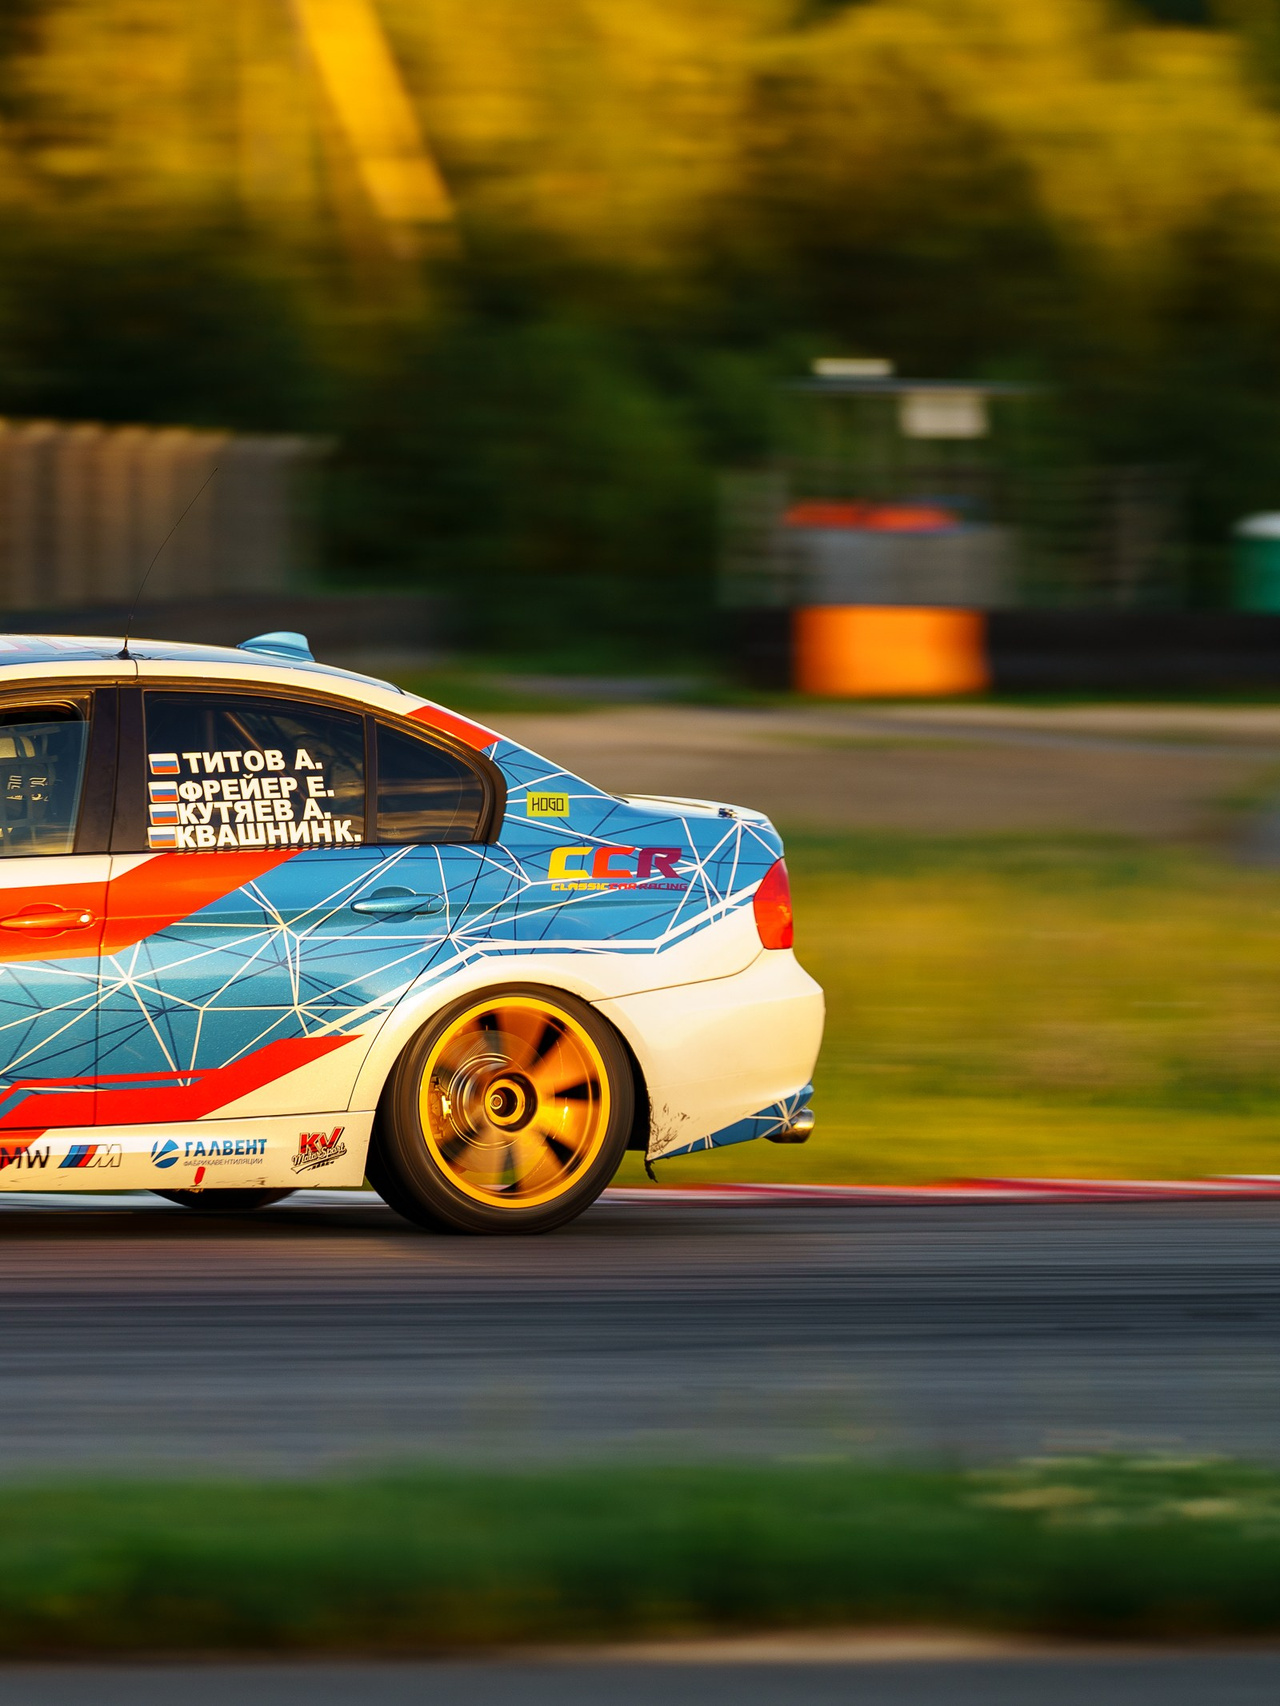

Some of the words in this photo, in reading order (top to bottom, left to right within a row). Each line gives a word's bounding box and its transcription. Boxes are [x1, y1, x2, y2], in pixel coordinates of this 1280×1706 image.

[182, 749, 285, 774] ТИТОВ
[294, 748, 323, 771] А.
[178, 774, 298, 802] ФРЕЙЕР
[307, 775, 335, 798] Е.
[178, 799, 294, 825] КУТЯЕВ
[303, 798, 332, 820] А.
[532, 797, 564, 811] HOGO
[547, 846, 682, 879] CCR
[184, 1138, 267, 1157] ГАЛВЕНТ
[299, 1126, 345, 1155] KV
